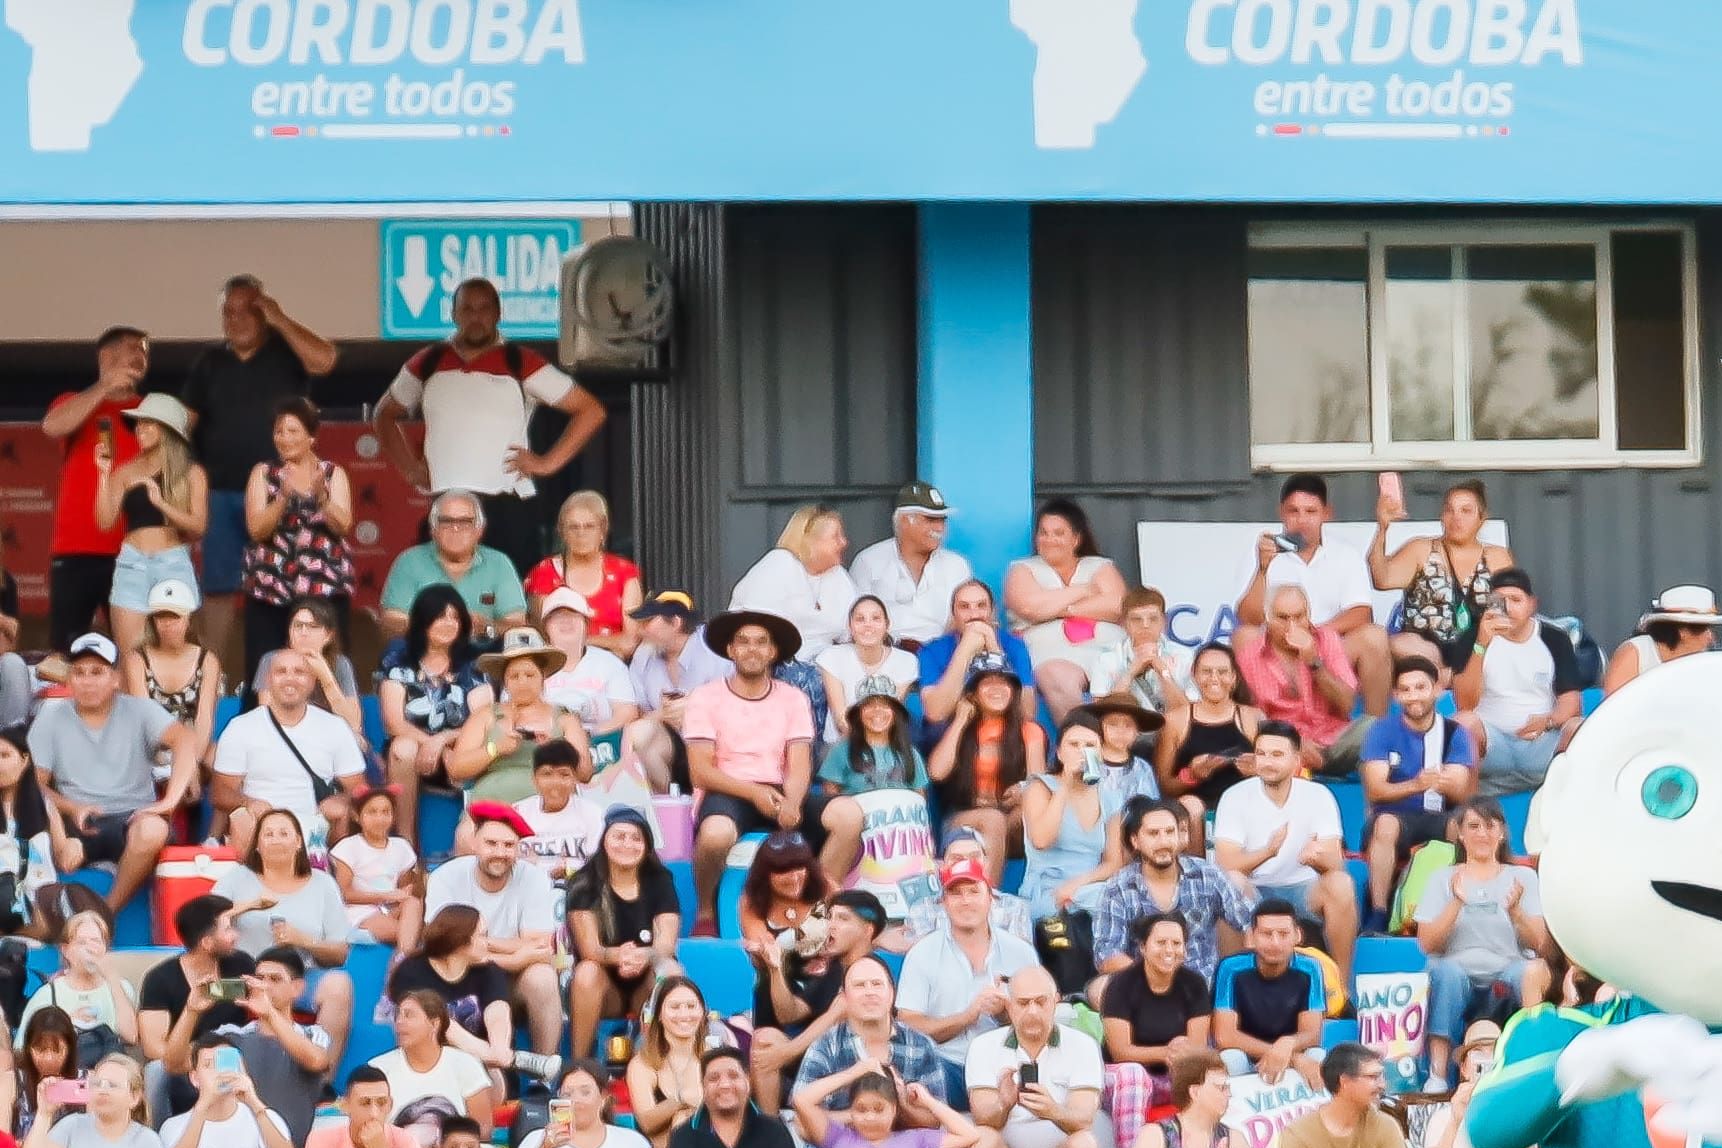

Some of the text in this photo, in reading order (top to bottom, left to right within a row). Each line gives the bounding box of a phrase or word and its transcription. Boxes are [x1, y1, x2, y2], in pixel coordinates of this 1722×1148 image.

[249, 68, 516, 117] entre todos
[1253, 69, 1514, 117] entre todos
[440, 234, 560, 293] SALIDA
[1358, 983, 1413, 1009] ANO
